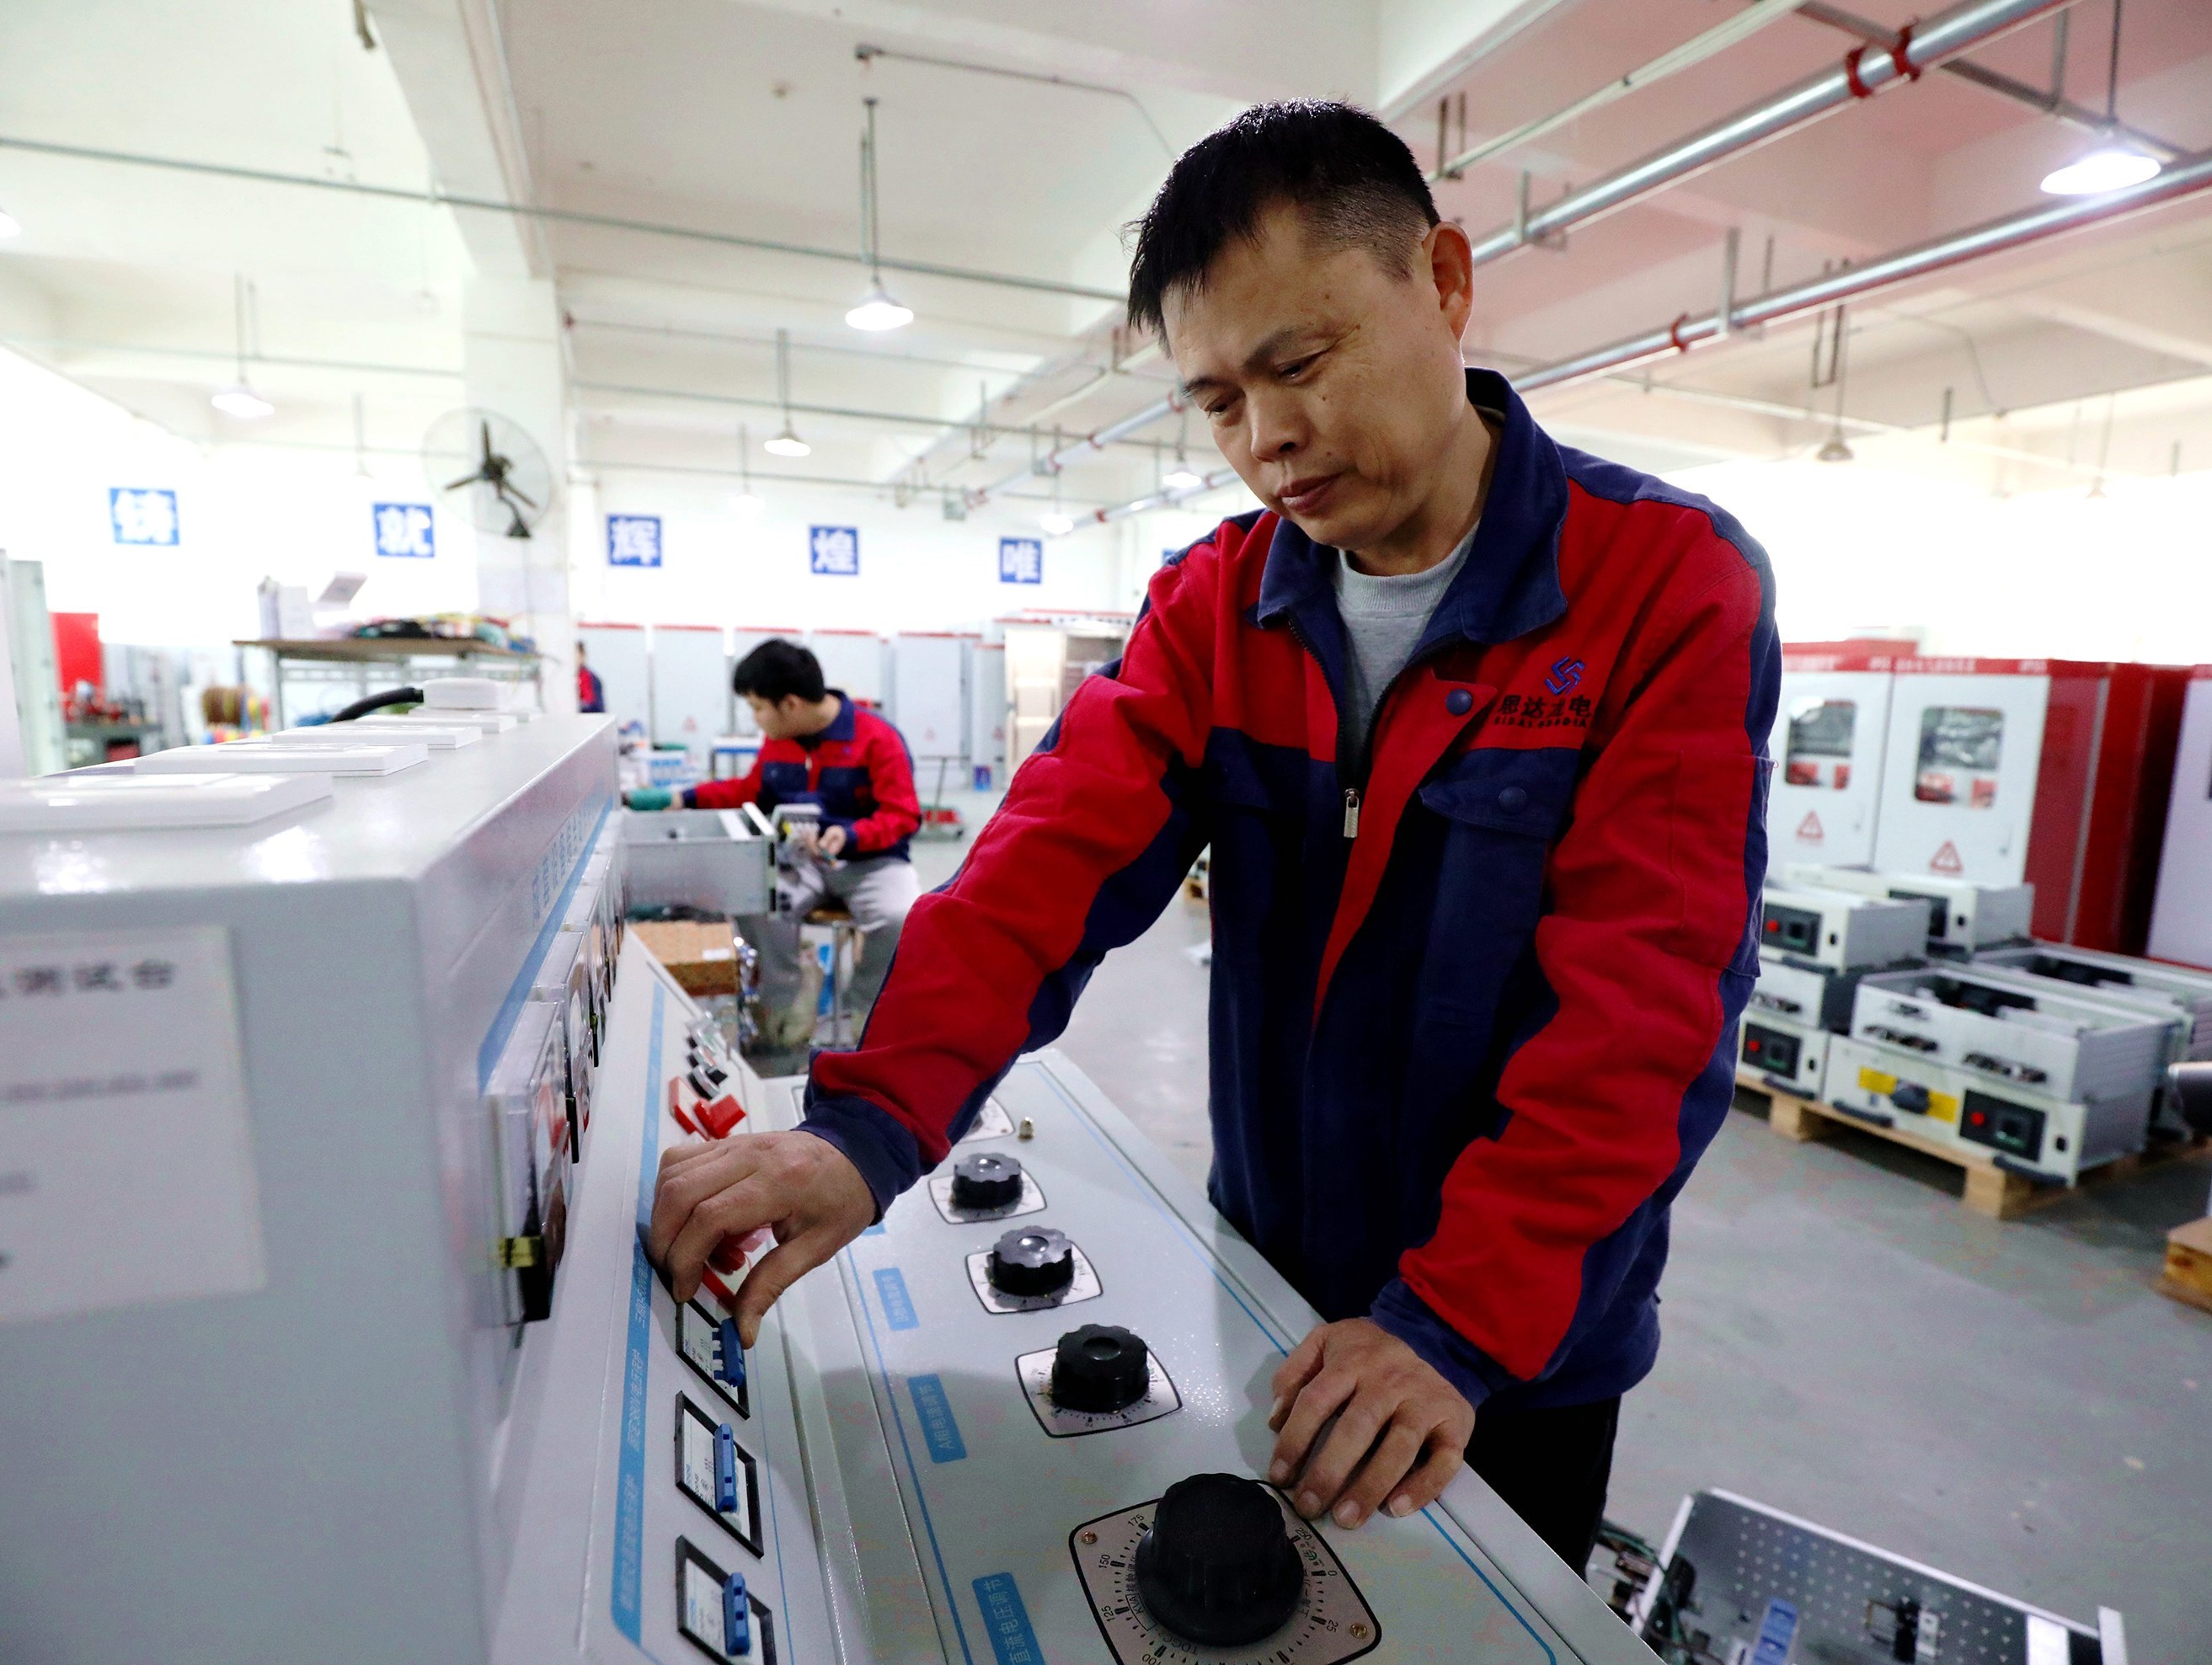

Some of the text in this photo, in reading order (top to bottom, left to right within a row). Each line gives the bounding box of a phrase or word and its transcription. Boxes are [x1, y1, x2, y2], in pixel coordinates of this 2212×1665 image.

[612, 516, 660, 565] 辉
[813, 529, 856, 574] 煌
[1127, 1513, 1145, 1528] 175
[1294, 1527, 1312, 1542] 250
[1098, 1554, 1111, 1569] 150
[1128, 1595, 1143, 1614] KVA
[984, 1577, 1032, 1665] 直流电压调节
[1101, 1605, 1115, 1622] 125
[1326, 1619, 1339, 1633] 25
